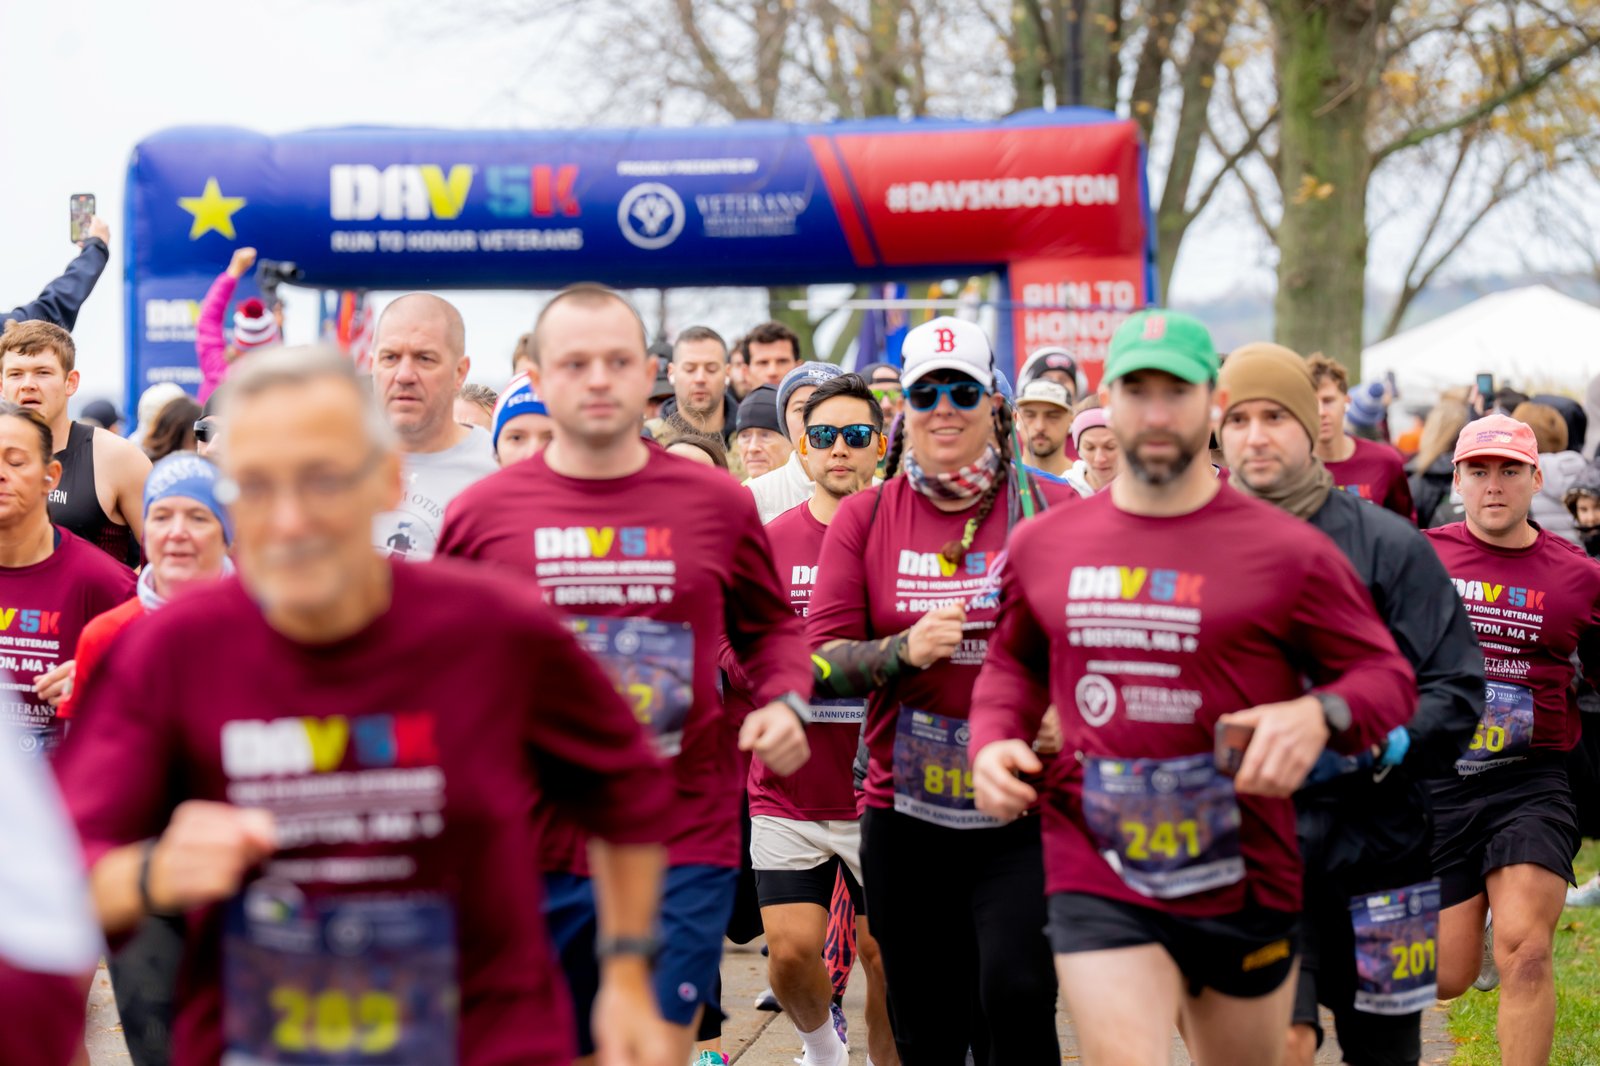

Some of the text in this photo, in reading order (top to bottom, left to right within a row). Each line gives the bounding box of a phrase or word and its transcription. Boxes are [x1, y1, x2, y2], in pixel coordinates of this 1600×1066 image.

[330, 163, 581, 221] DAV 5K
[330, 228, 583, 252] RUN TO HONOR VETERANS
[1095, 281, 1136, 307] TO
[934, 328, 955, 352] B
[411, 493, 444, 519] OTIS
[534, 526, 673, 559] DAV 5K
[554, 584, 657, 606] BOSTON, MA
[791, 589, 806, 597] RUN
[1068, 566, 1204, 604] DAV 5K
[1508, 586, 1546, 610] 5K
[19, 609, 61, 635] 5K
[1473, 604, 1501, 616] HONOR
[1502, 609, 1543, 623] VETERANS
[15, 637, 60, 650] VETERANS
[1081, 627, 1181, 652] BOSTON, MA
[1507, 627, 1526, 640] MA
[1512, 647, 1521, 655] BY
[21, 658, 44, 672] MA
[1121, 820, 1200, 860] 241
[1392, 939, 1436, 979] 201
